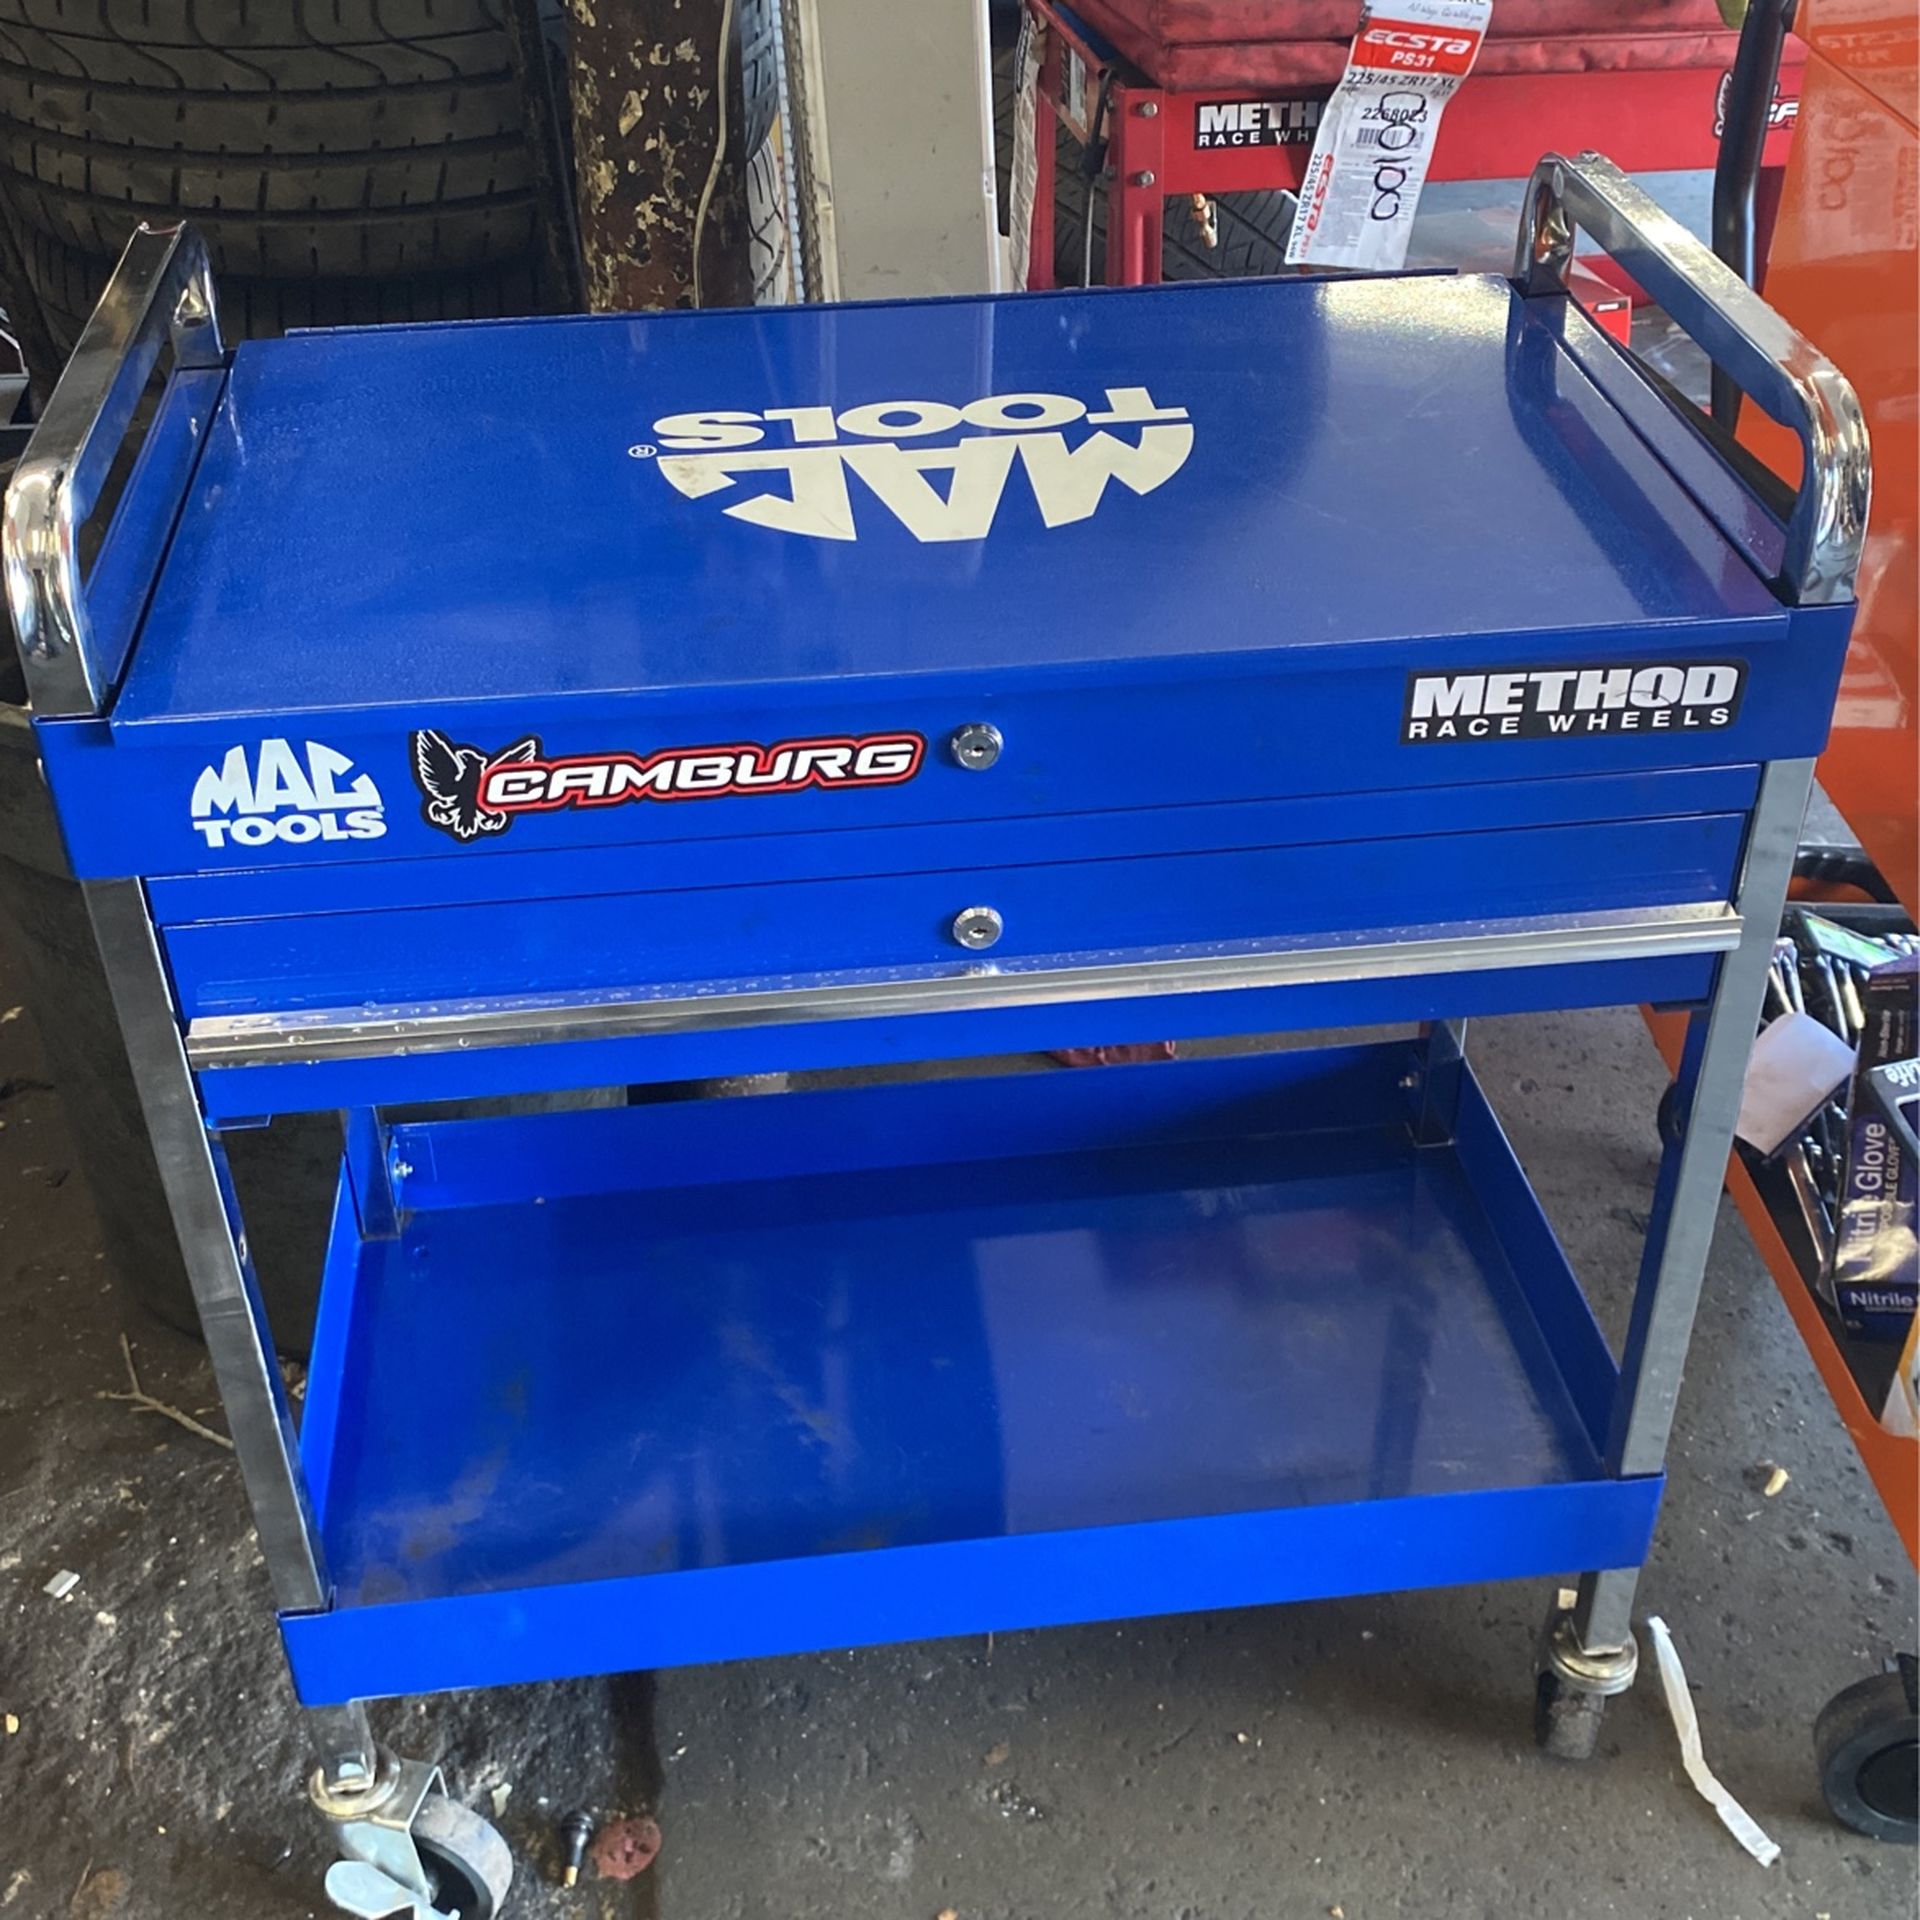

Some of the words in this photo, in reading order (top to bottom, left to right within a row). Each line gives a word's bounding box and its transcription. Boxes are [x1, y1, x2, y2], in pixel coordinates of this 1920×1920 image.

[1390, 51, 1436, 68] PS31
[1346, 71, 1397, 86] 225/45
[1397, 75, 1438, 86] ZR17
[1441, 77, 1456, 89] XL
[1199, 101, 1320, 133] METH
[1199, 131, 1260, 147] RACE
[1304, 153, 1323, 192] 225/45
[1297, 194, 1313, 222] ZR17
[652, 386, 1190, 449] TOOLS
[656, 422, 1194, 543] MAC
[1411, 665, 1739, 719] METHOD
[1408, 716, 1520, 739] RACE
[1548, 707, 1730, 732] WHEELS
[191, 738, 382, 818] MAC
[486, 743, 915, 804] CAMBURG
[192, 810, 387, 848] TOOLS
[1855, 1123, 1886, 1191] Glove
[1847, 1194, 1879, 1262] Nitrie
[1850, 1291, 1915, 1307] Nitrile
